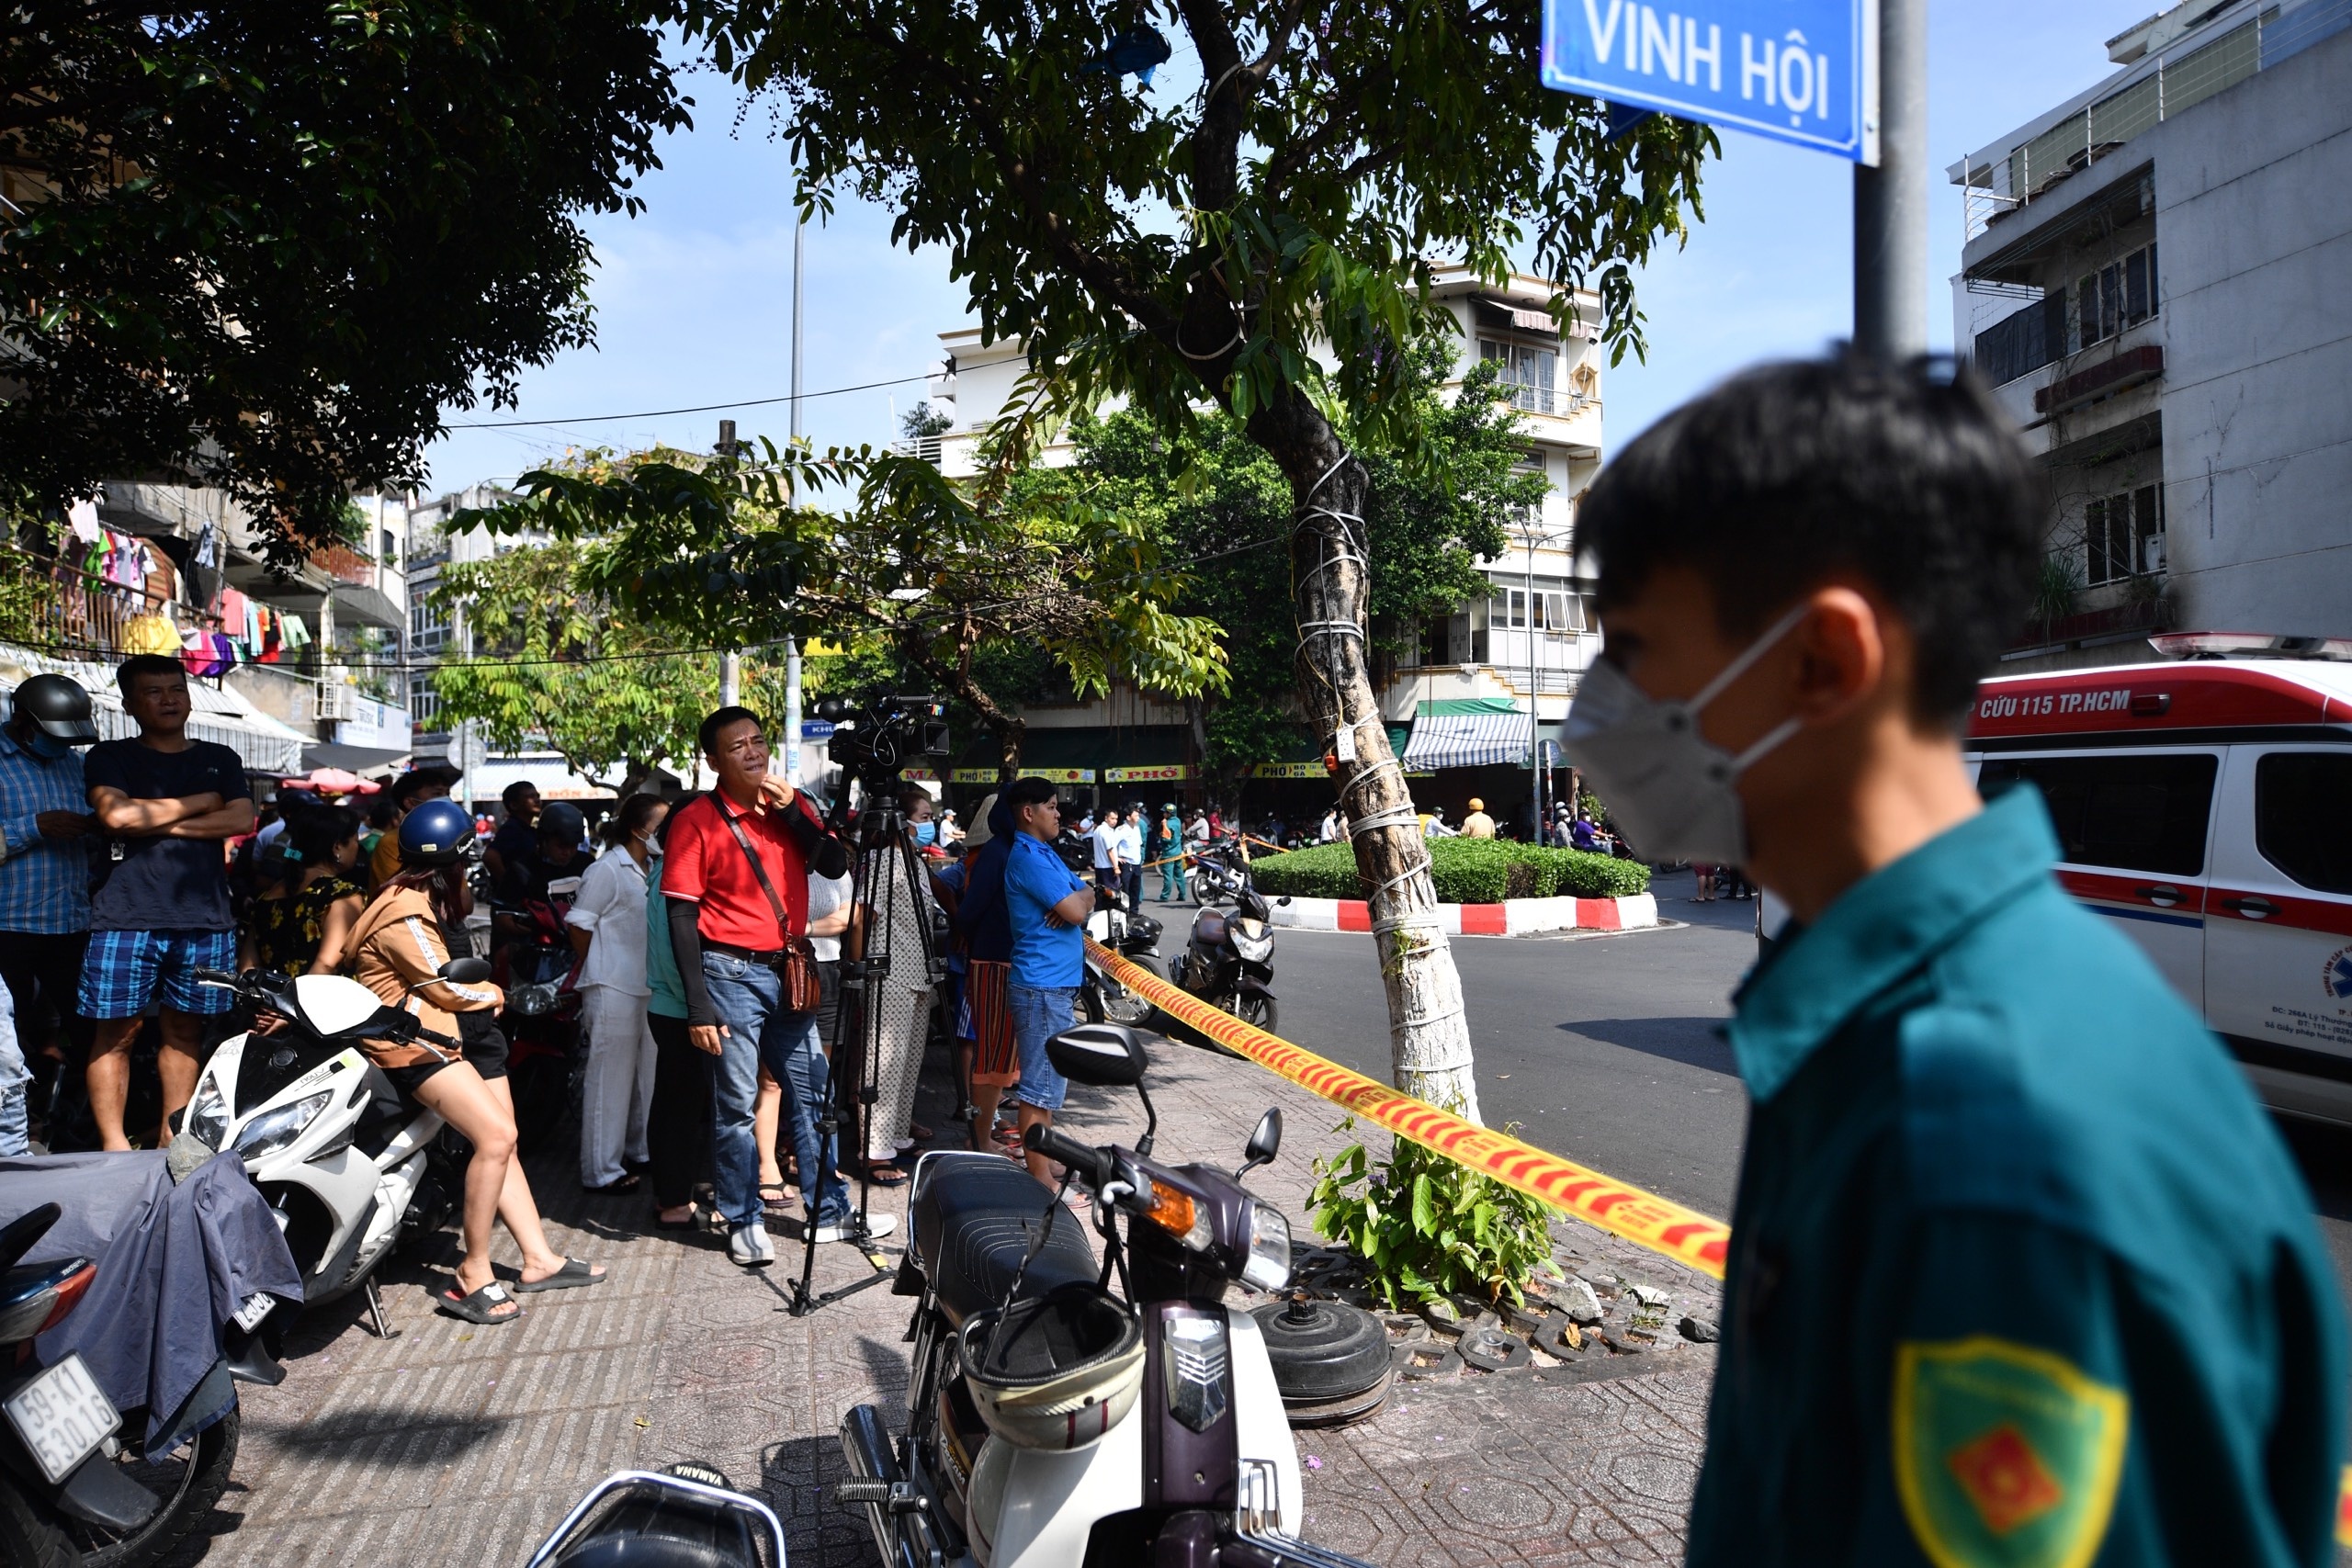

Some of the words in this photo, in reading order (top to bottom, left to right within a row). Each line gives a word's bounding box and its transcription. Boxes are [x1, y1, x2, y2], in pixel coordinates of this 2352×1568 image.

[1741, 29, 1828, 128] HỘI
[1980, 695, 2018, 718] CỨU
[2021, 695, 2053, 716] 115
[2059, 690, 2132, 713] TP.HCM
[676, 1465, 721, 1486] YAMAHA
